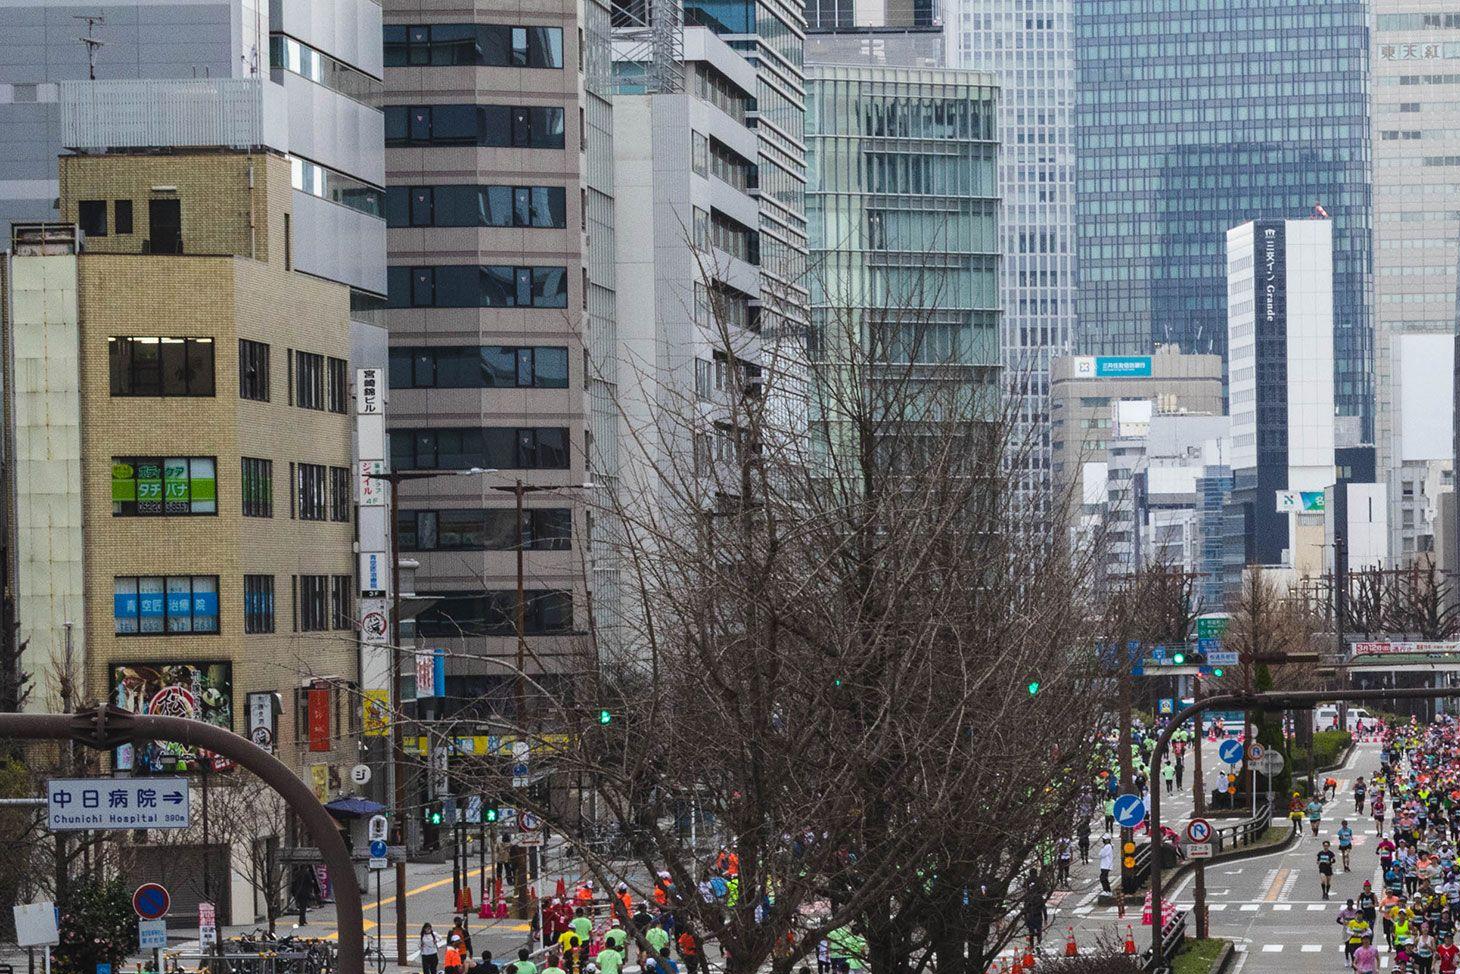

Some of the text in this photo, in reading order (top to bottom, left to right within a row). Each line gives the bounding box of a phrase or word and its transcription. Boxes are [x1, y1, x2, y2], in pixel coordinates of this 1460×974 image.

[1381, 44, 1440, 59] 東天紅
[1266, 240, 1275, 321] 三交イン Grande
[139, 483, 188, 497] タチバナ
[53, 789, 157, 808] 中日病院
[53, 814, 102, 823] Chunichi
[109, 814, 158, 824] Hospital
